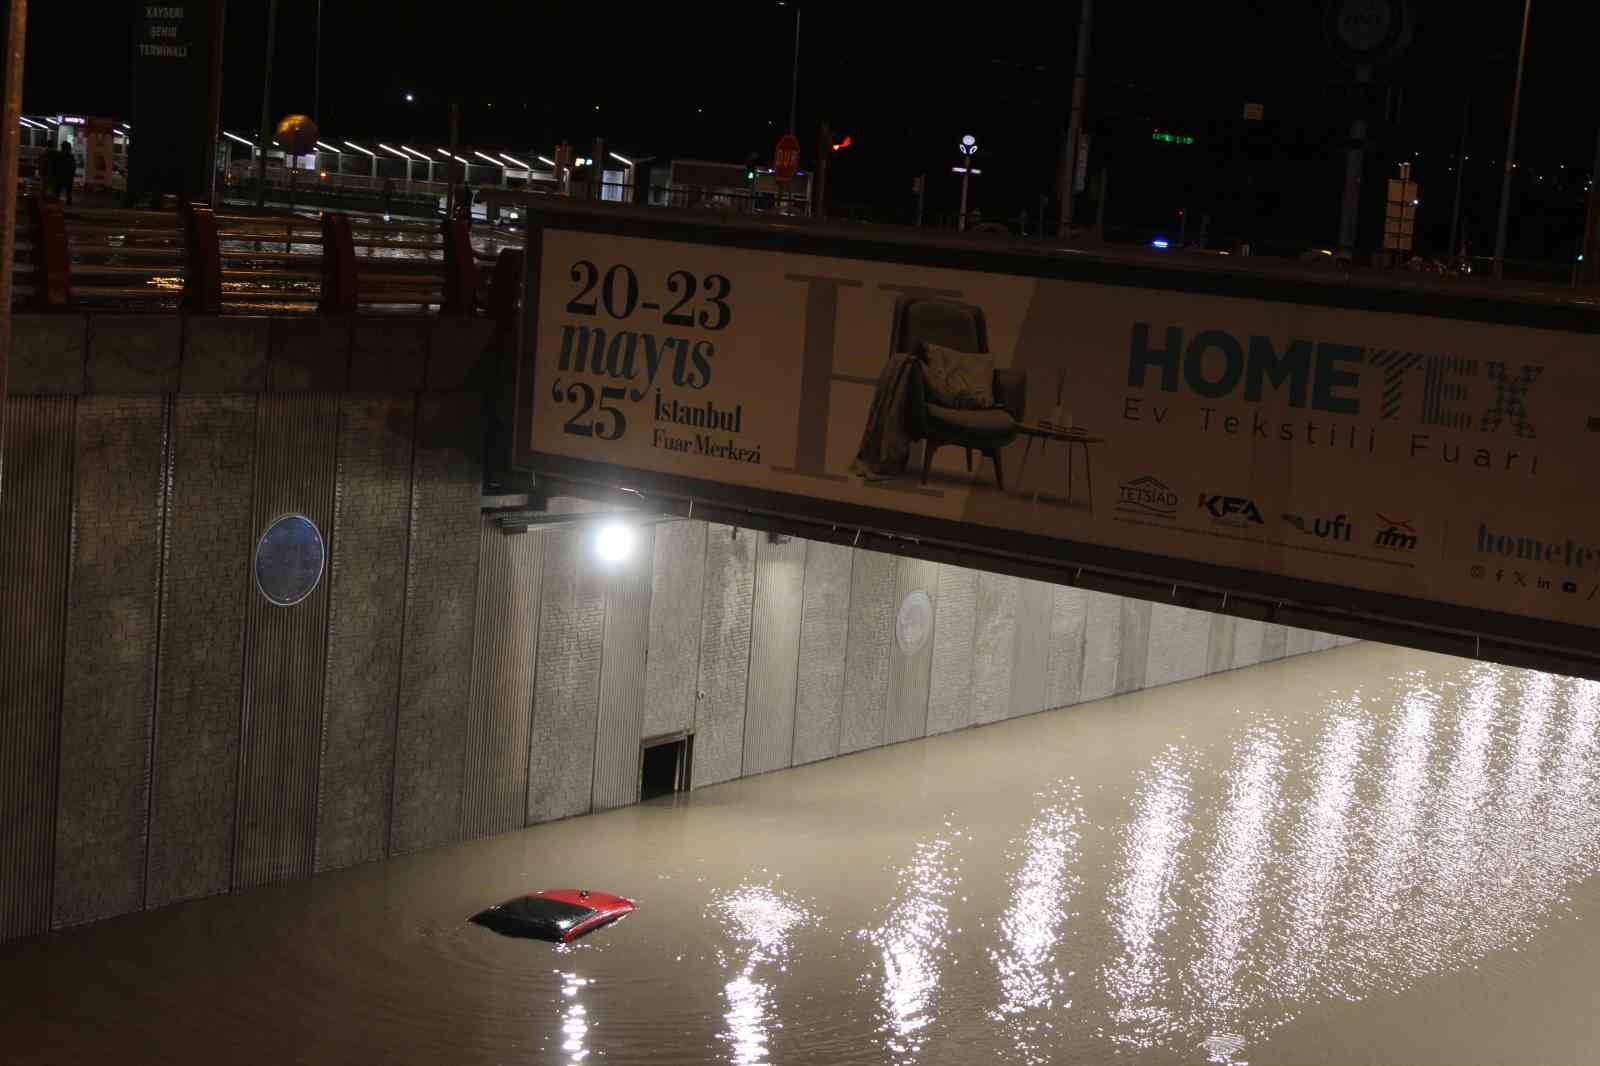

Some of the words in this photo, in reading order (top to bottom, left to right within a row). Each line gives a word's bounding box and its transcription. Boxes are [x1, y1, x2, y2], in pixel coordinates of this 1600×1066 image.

[565, 260, 732, 330] 20-23
[557, 324, 716, 402] mayıs
[1127, 320, 1545, 439] HOMETEX
[654, 387, 742, 433] İstanbul
[1123, 397, 1168, 424] Ev
[1199, 406, 1375, 453] Tekstili
[1409, 432, 1538, 475] Fuarı
[653, 428, 693, 450] Fuar
[695, 433, 761, 465] Merkezi
[1198, 493, 1265, 525] KFA
